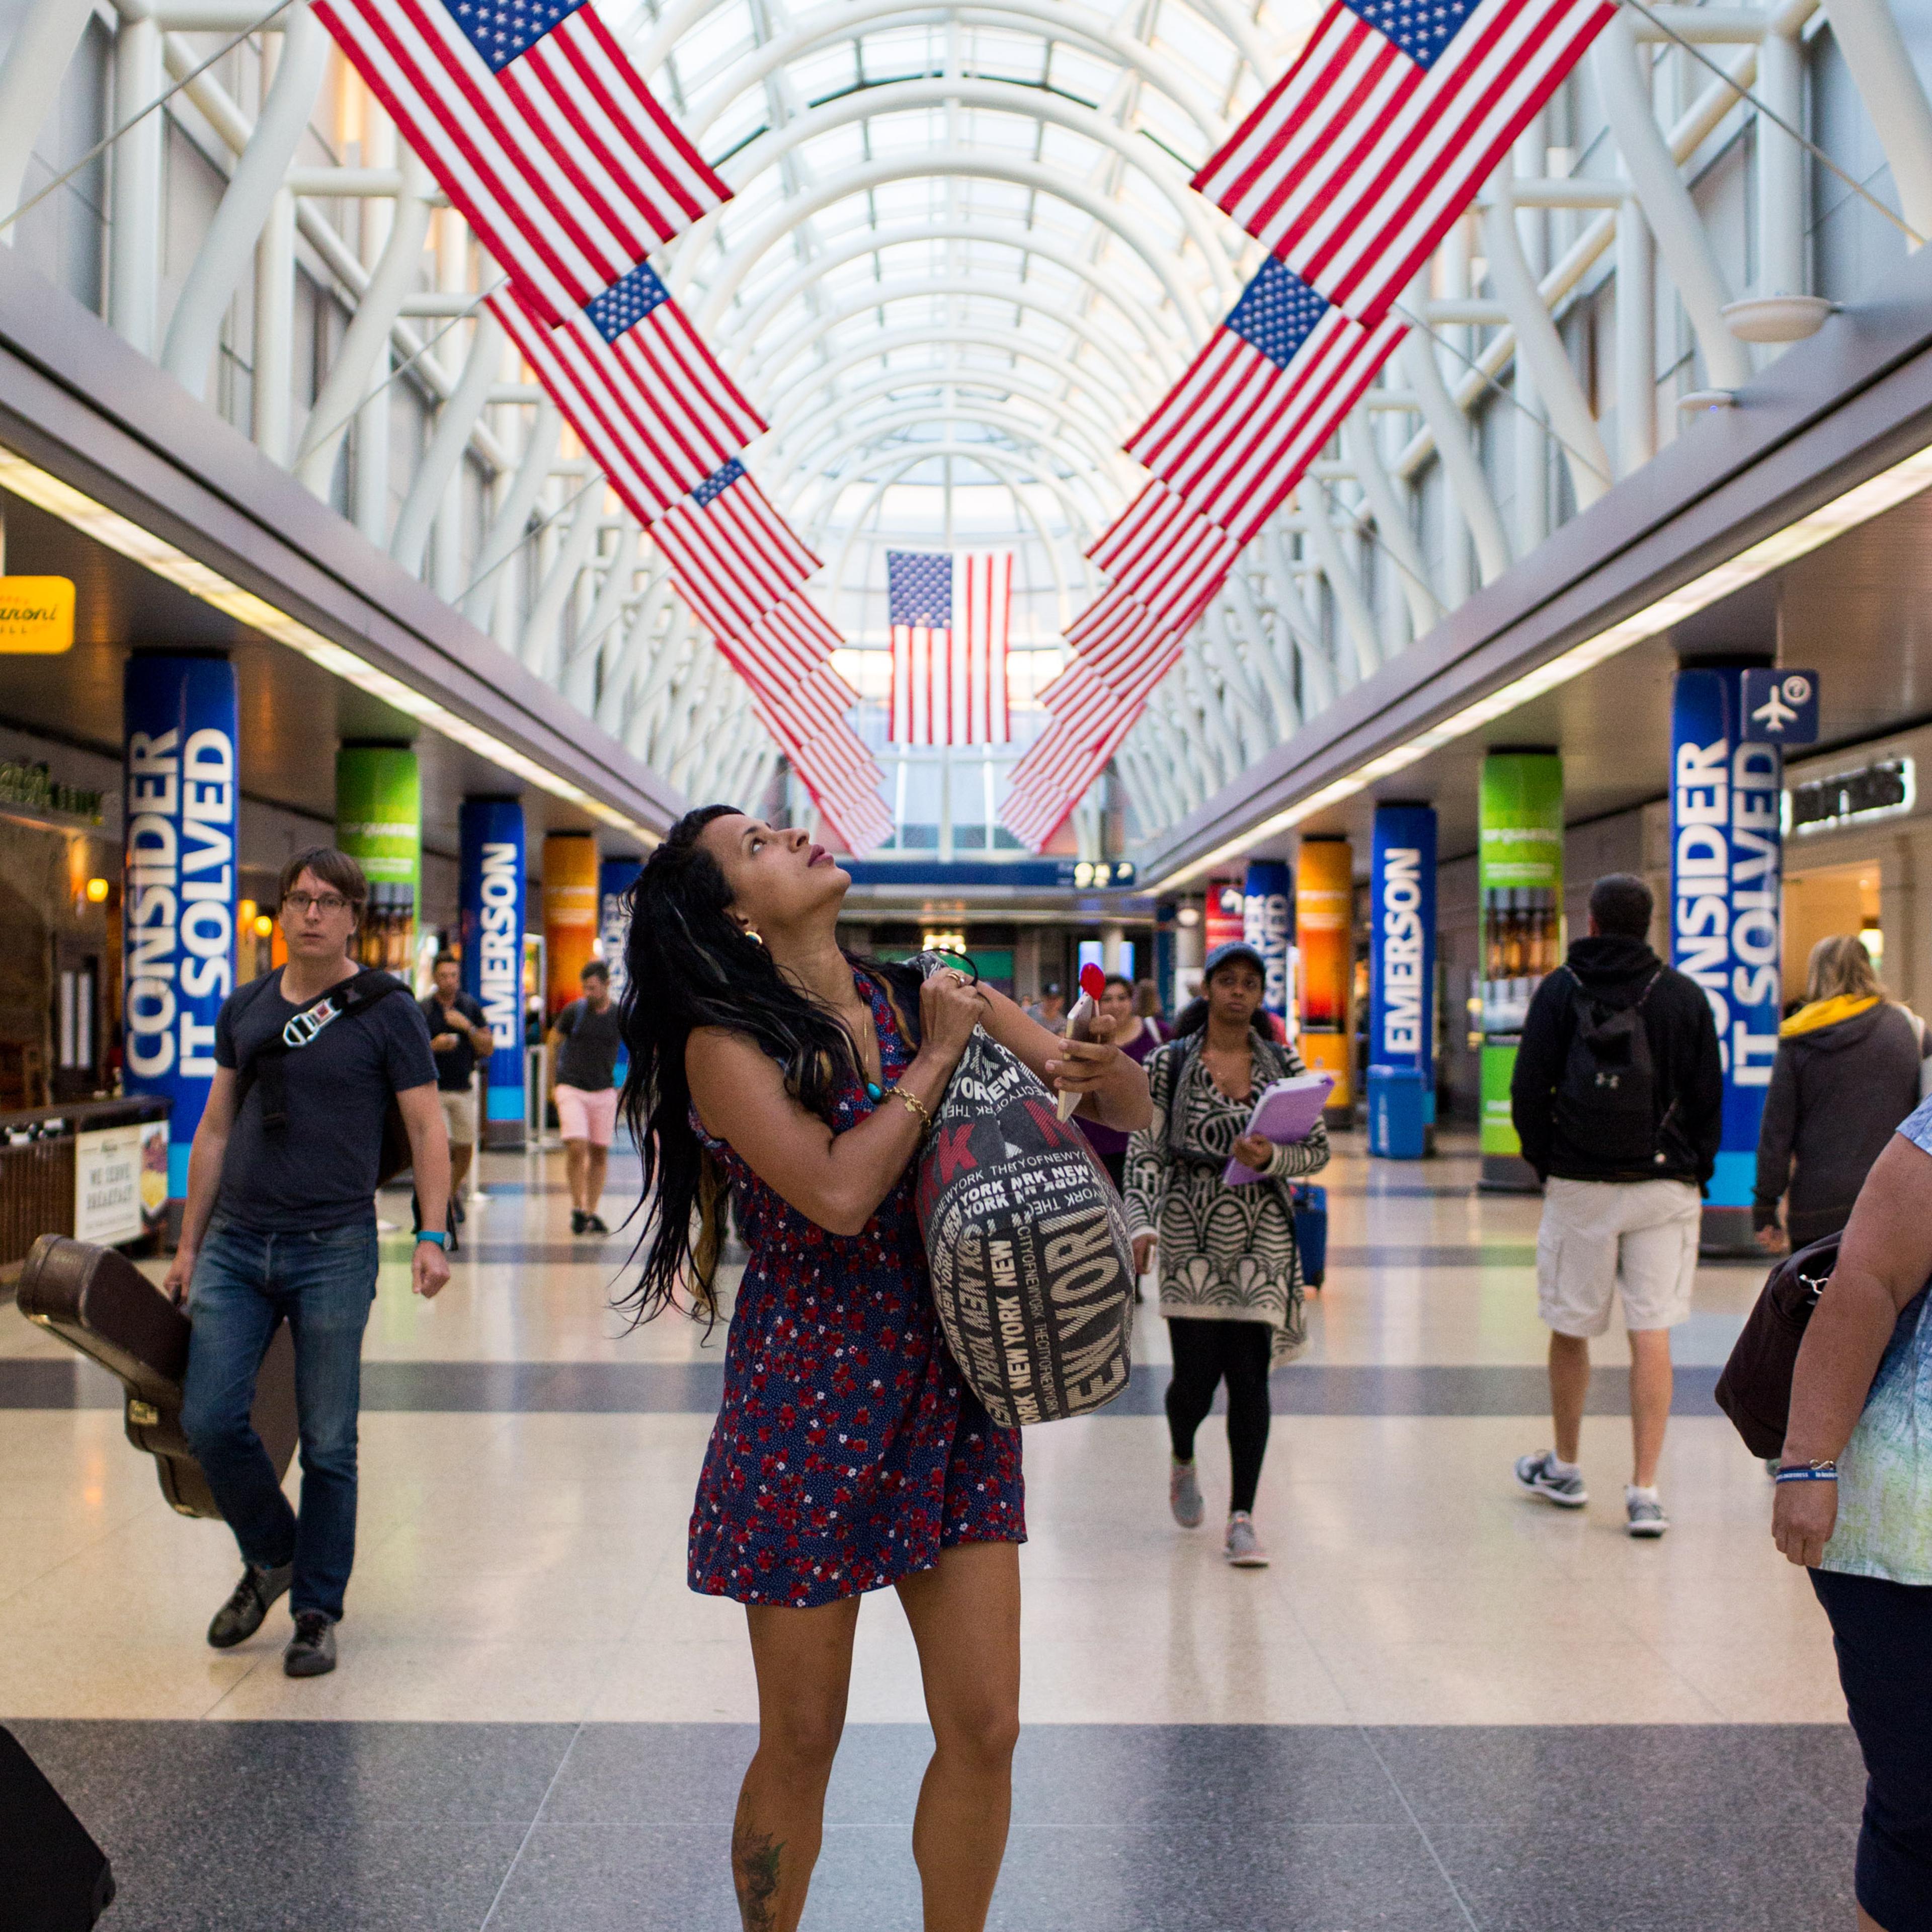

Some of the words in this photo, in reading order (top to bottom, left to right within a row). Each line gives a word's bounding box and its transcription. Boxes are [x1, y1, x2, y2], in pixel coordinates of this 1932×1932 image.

[180, 728, 233, 999] SOLVED
[1731, 741, 1780, 1006] SOLVED
[126, 726, 179, 1079] CONSIDER
[1677, 737, 1730, 1075] NSIDER
[480, 842, 518, 1050] EMERSON
[1384, 847, 1423, 1054] EMERSON
[180, 1011, 218, 1078] IT
[1732, 1020, 1779, 1086] IT
[959, 1180, 1005, 1206] YORK
[1051, 1164, 1089, 1179] NEW
[963, 1193, 1010, 1220] YORK
[988, 1240, 1018, 1287] NEW
[995, 1295, 1026, 1347] YORK
[1004, 1348, 1032, 1390] NEW
[1061, 1323, 1130, 1417] EW
[1012, 1392, 1042, 1426] ORK
